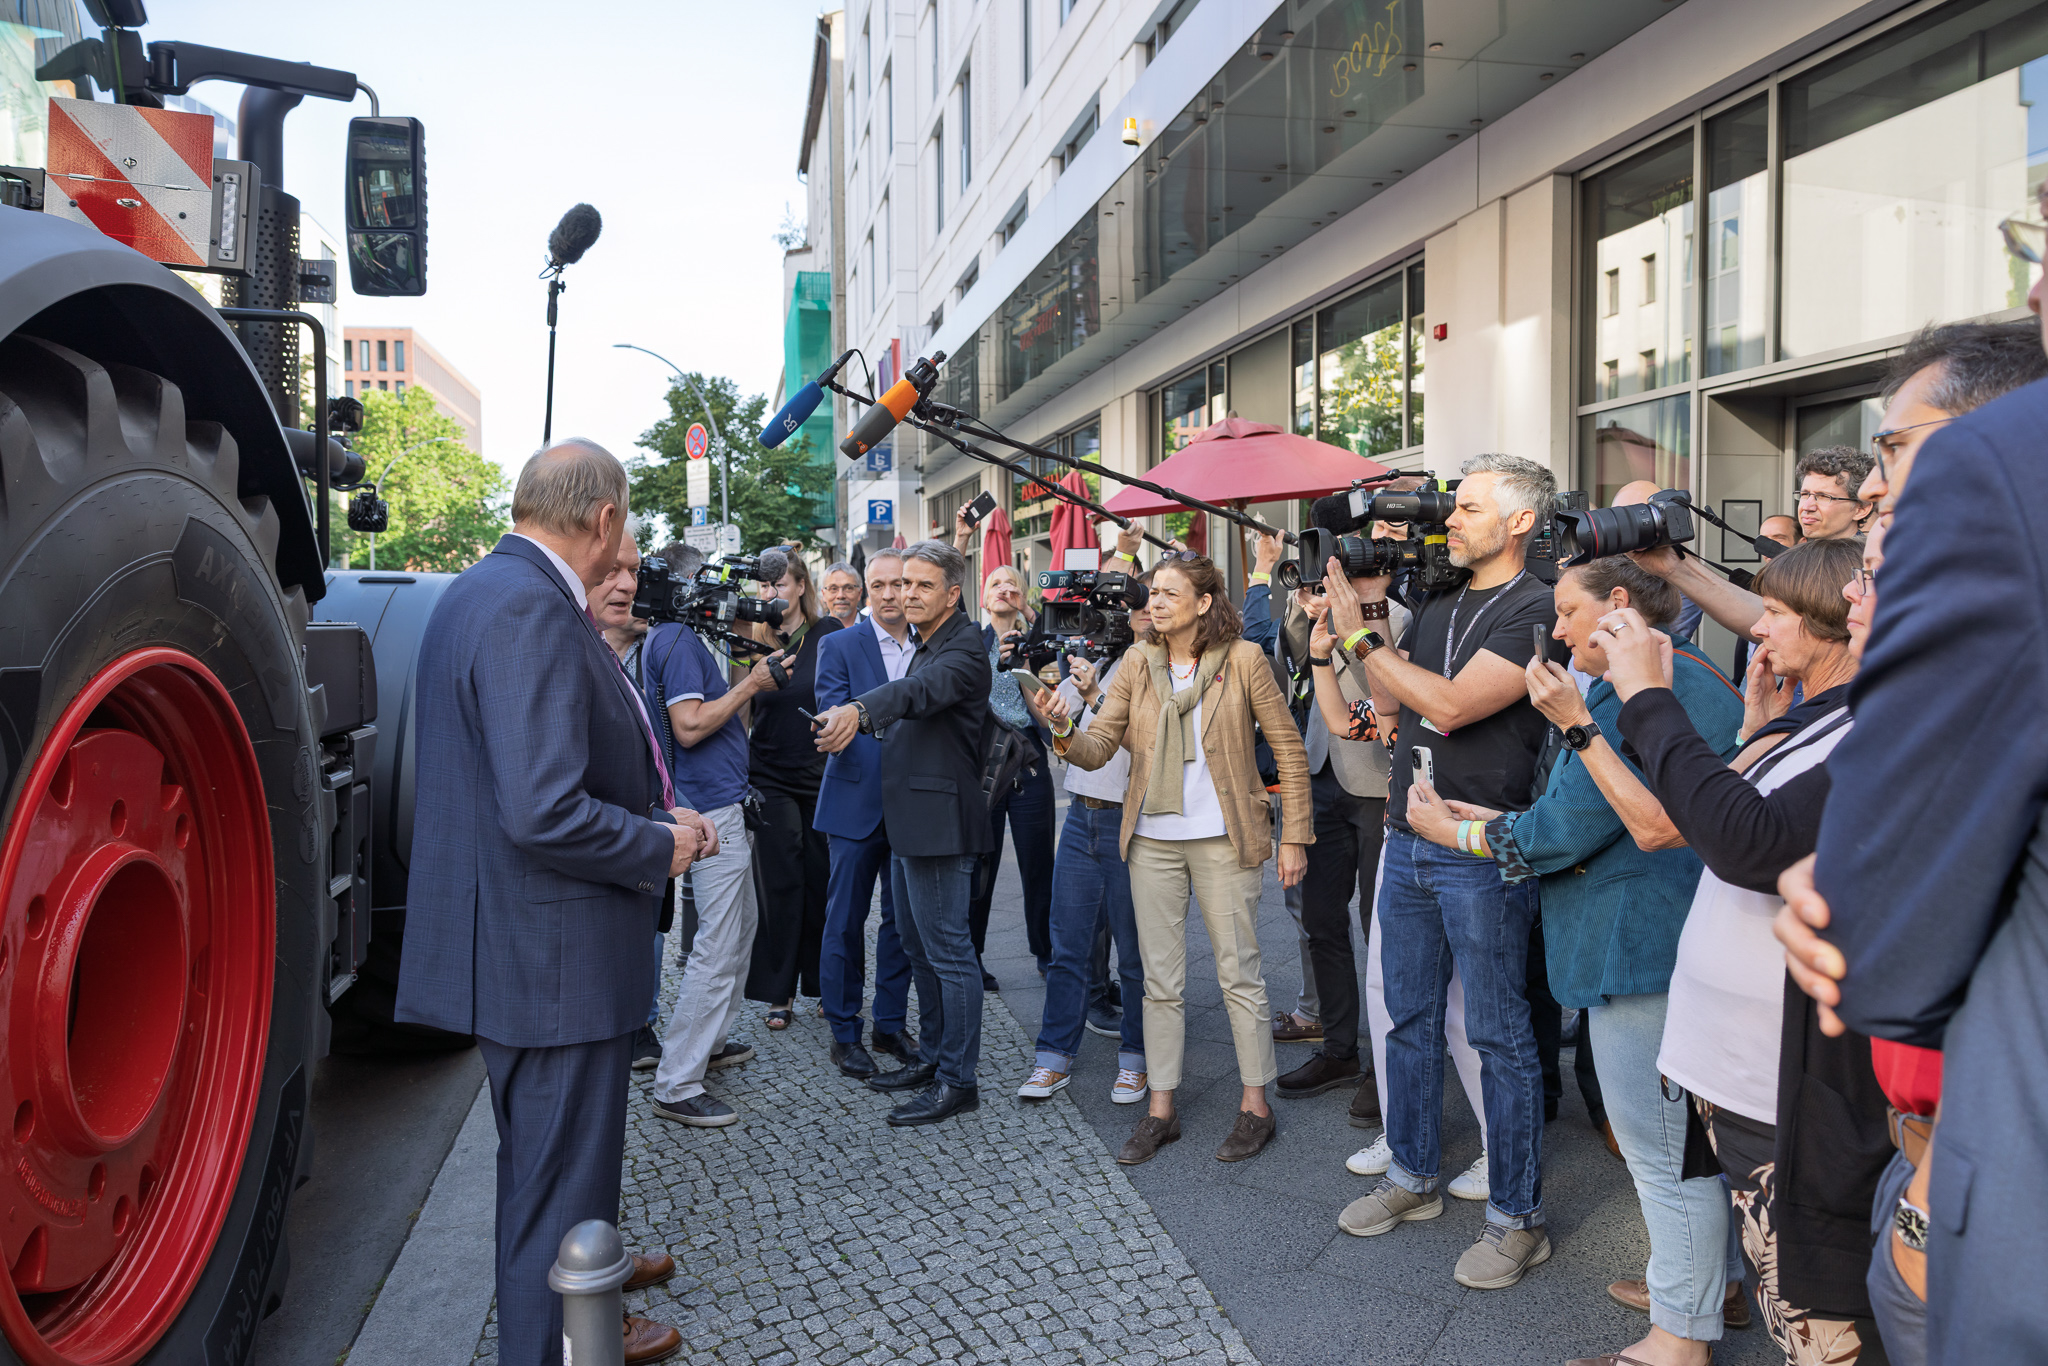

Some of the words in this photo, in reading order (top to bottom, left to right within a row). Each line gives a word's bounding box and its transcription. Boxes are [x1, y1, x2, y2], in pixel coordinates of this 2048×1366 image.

[783, 413, 798, 433] BR
[694, 507, 703, 525] P
[875, 505, 887, 520] P
[1286, 656, 1295, 673] SONY
